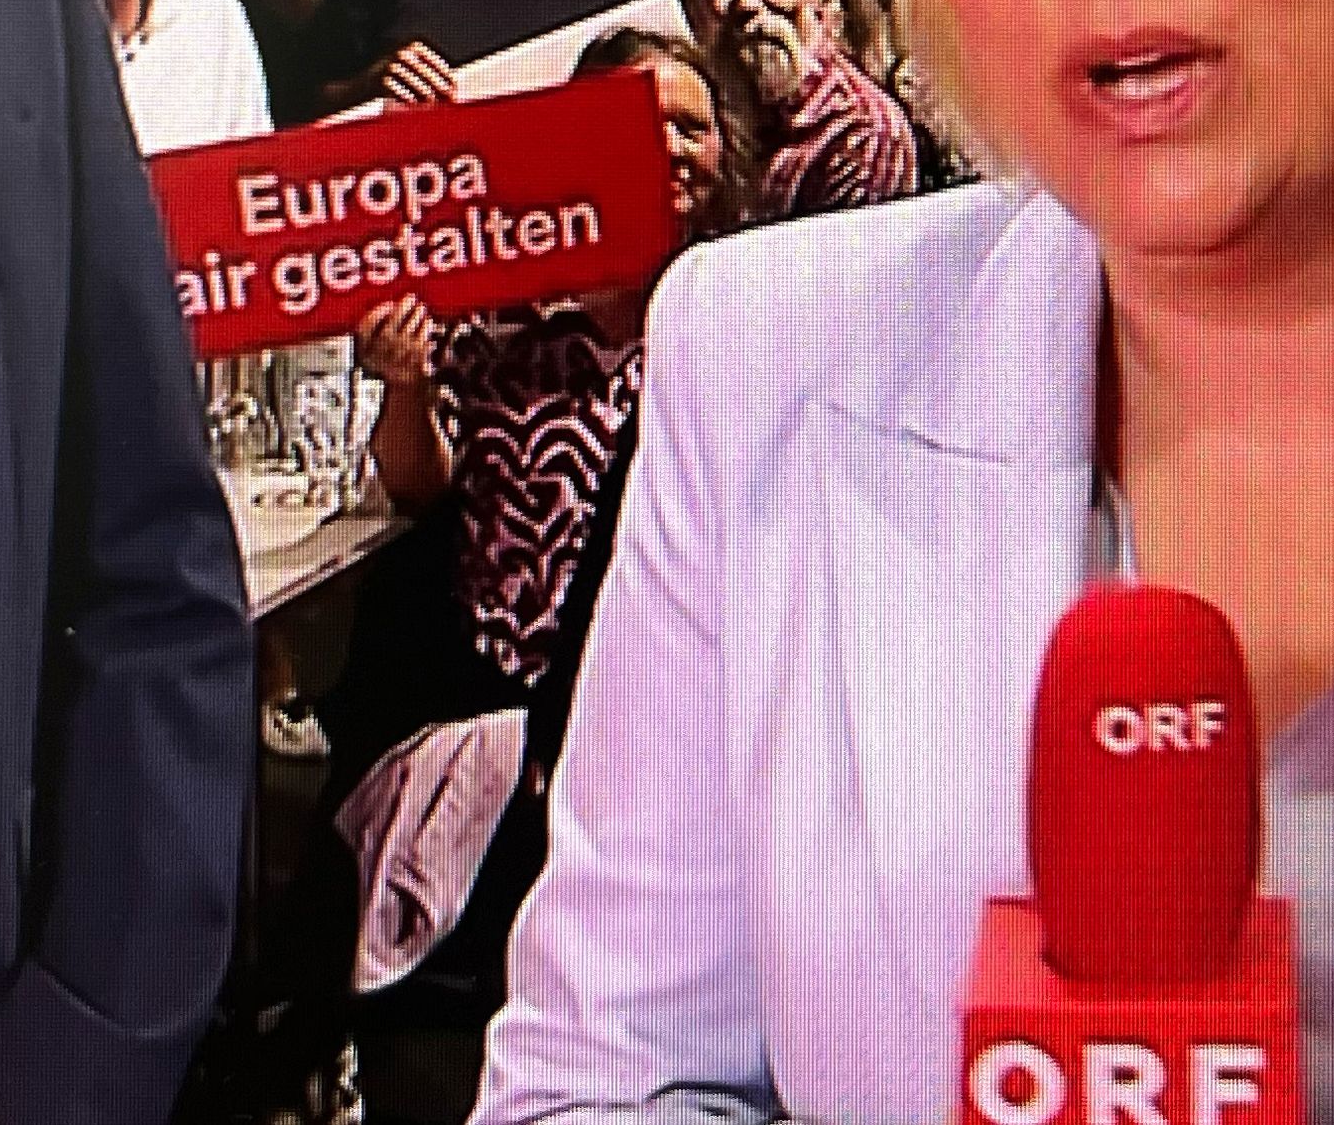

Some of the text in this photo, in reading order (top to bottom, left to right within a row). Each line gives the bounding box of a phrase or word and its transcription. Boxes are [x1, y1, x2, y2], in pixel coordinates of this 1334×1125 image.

[237, 153, 488, 236] Europa
[173, 200, 600, 317] air gestalten
[1095, 699, 1227, 754] ORF
[968, 1039, 1267, 1125] ORF
